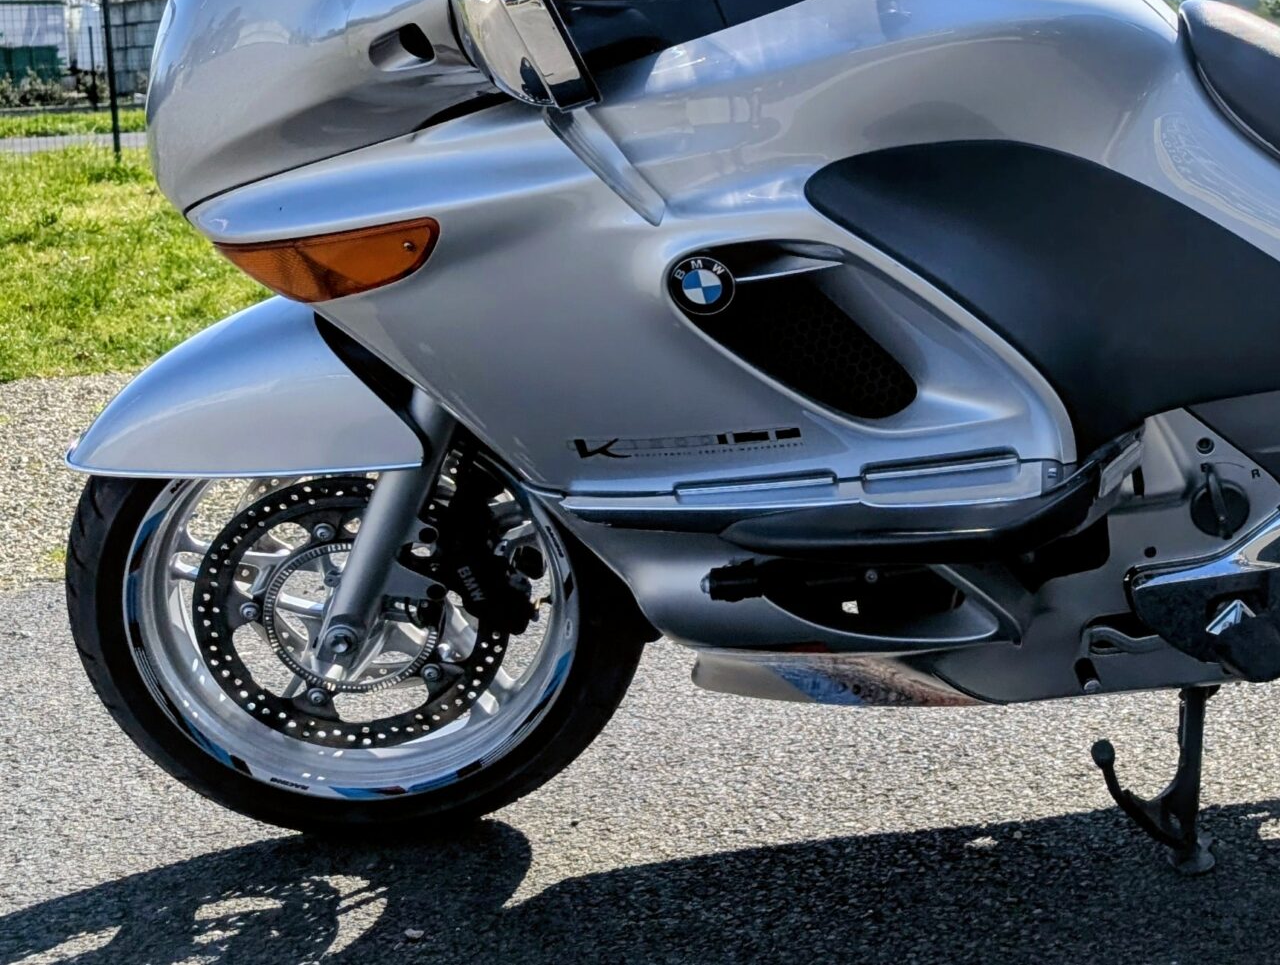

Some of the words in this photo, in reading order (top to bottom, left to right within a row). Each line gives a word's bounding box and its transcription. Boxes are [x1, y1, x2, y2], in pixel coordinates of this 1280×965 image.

[673, 259, 726, 281] BMW
[1251, 468, 1261, 479] R
[457, 565, 487, 602] BMW
